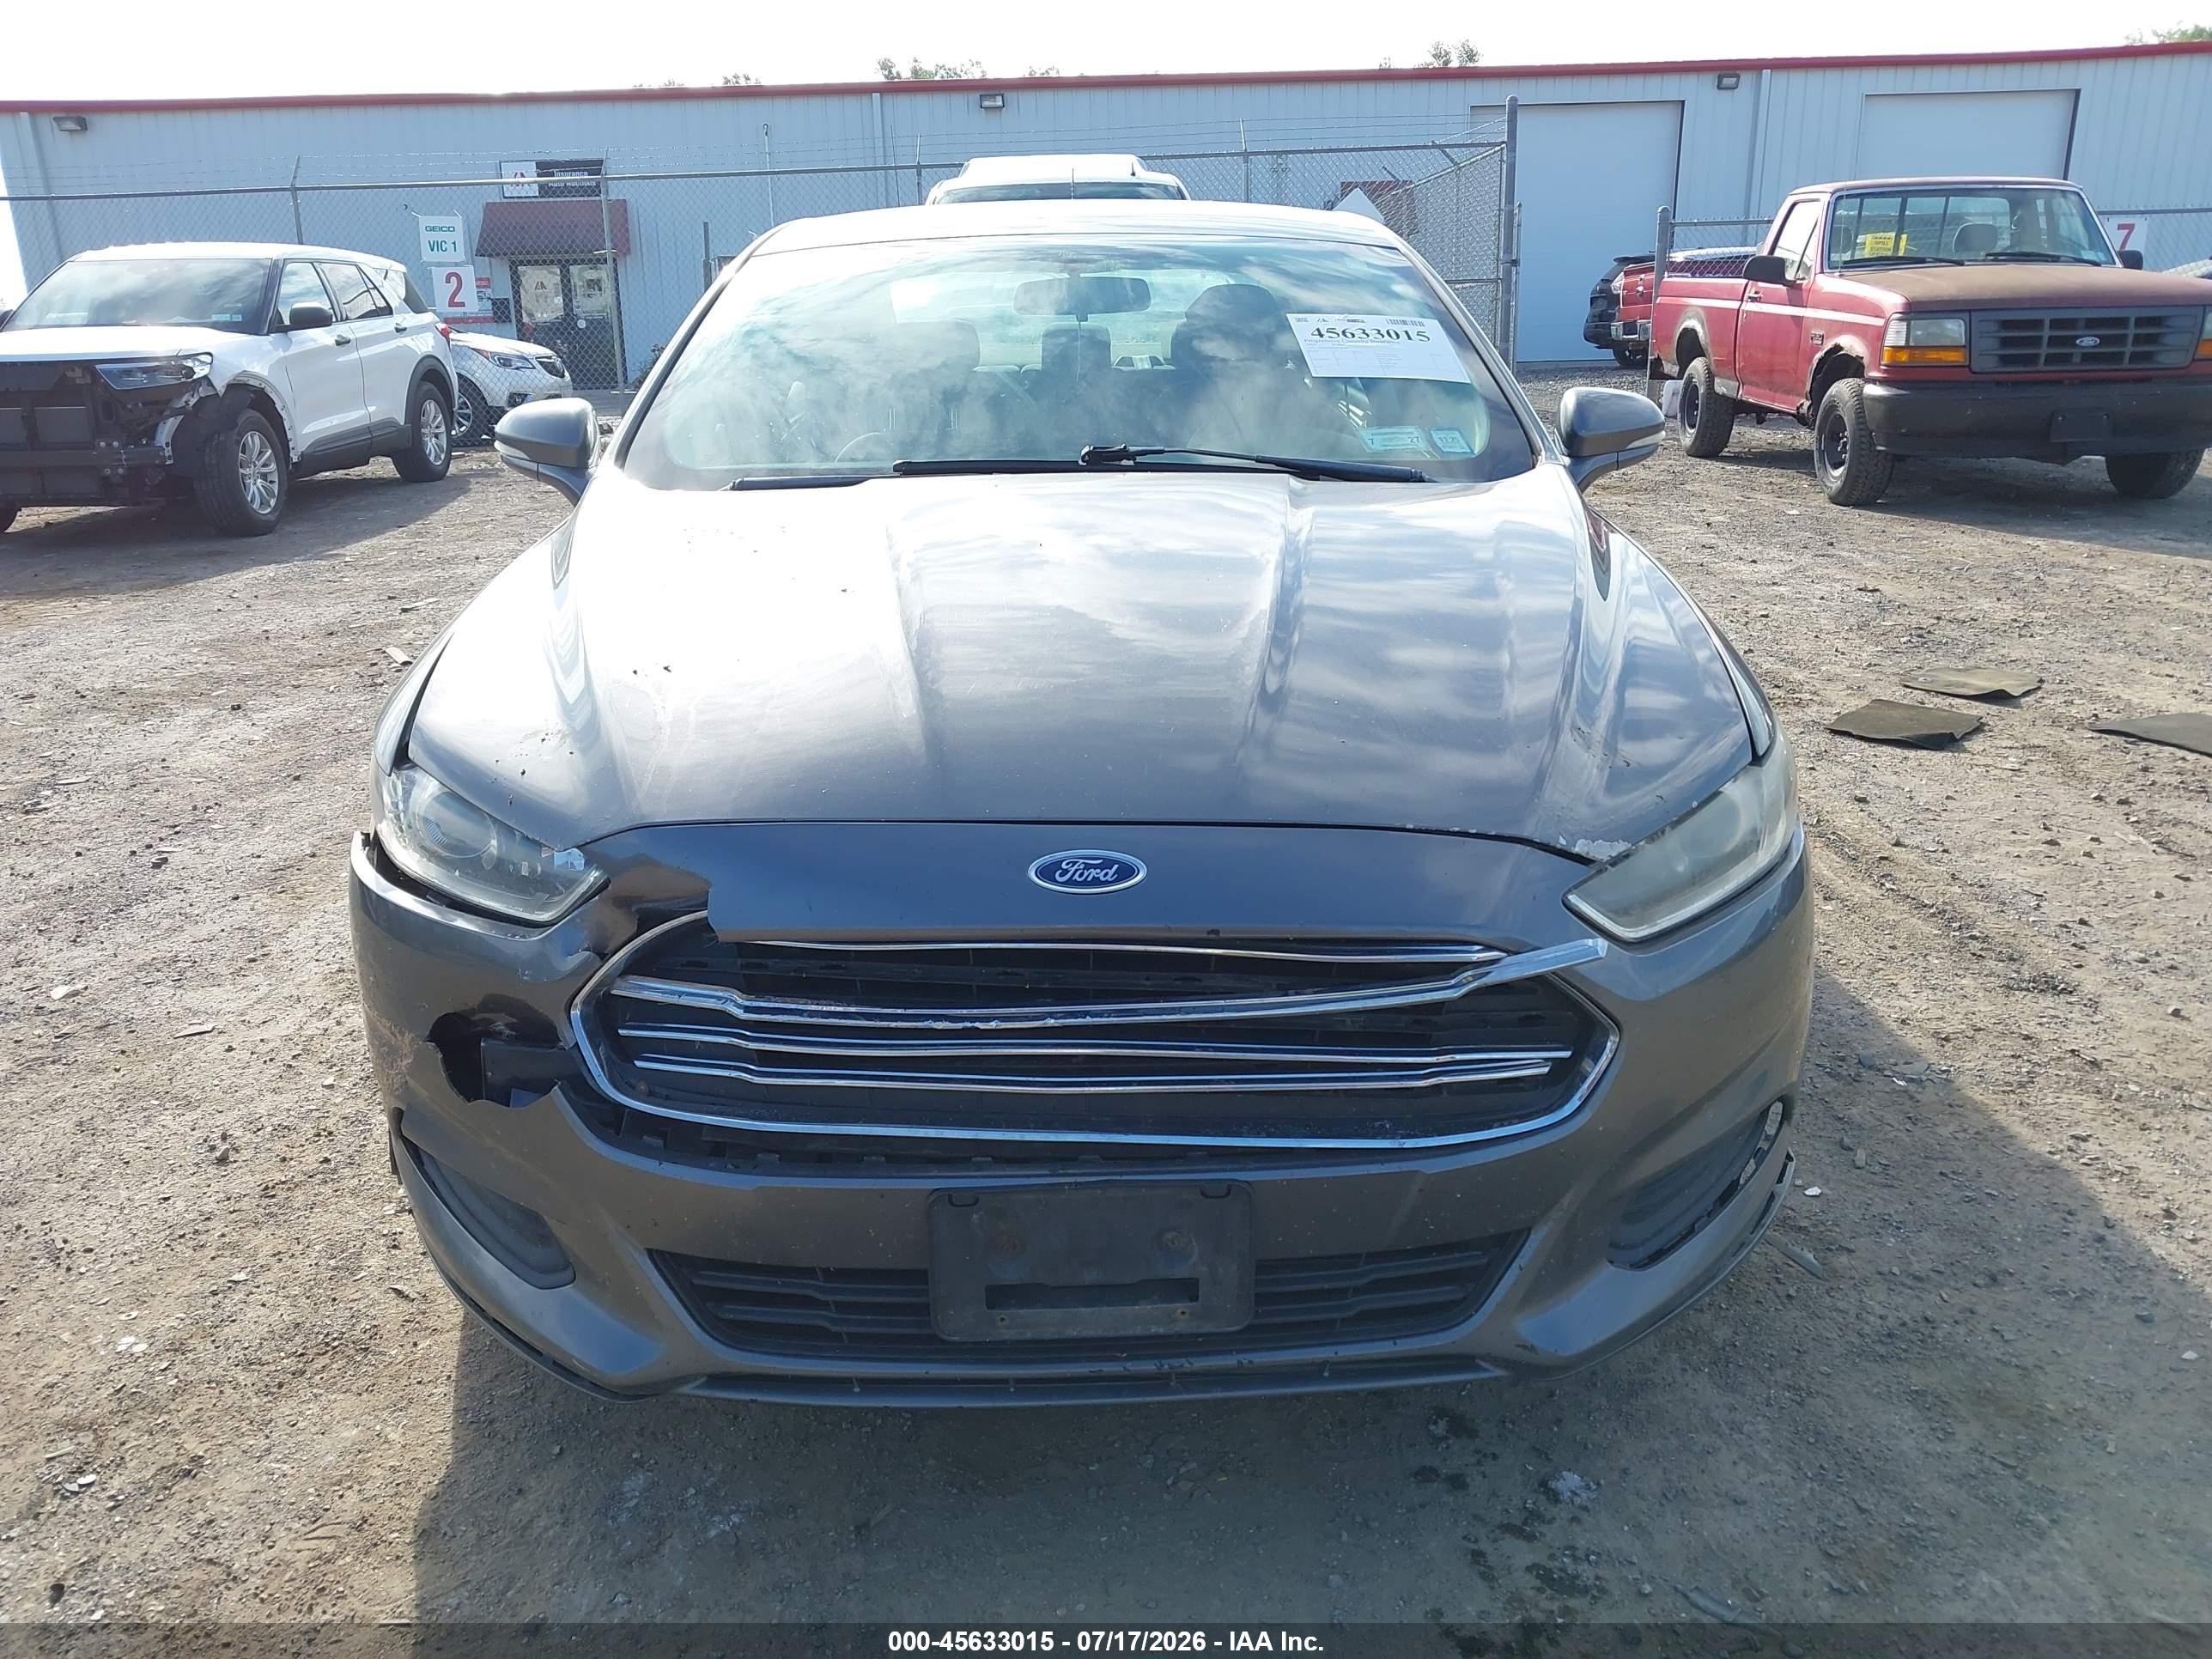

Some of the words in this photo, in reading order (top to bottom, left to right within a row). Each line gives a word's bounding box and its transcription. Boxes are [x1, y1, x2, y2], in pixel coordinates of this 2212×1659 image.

[428, 240, 448, 252] VIC
[451, 240, 458, 252] 1
[2117, 222, 2136, 252] 7
[445, 271, 465, 307] 2
[1310, 326, 1431, 343] 45633015
[1054, 858, 1120, 883] Ford
